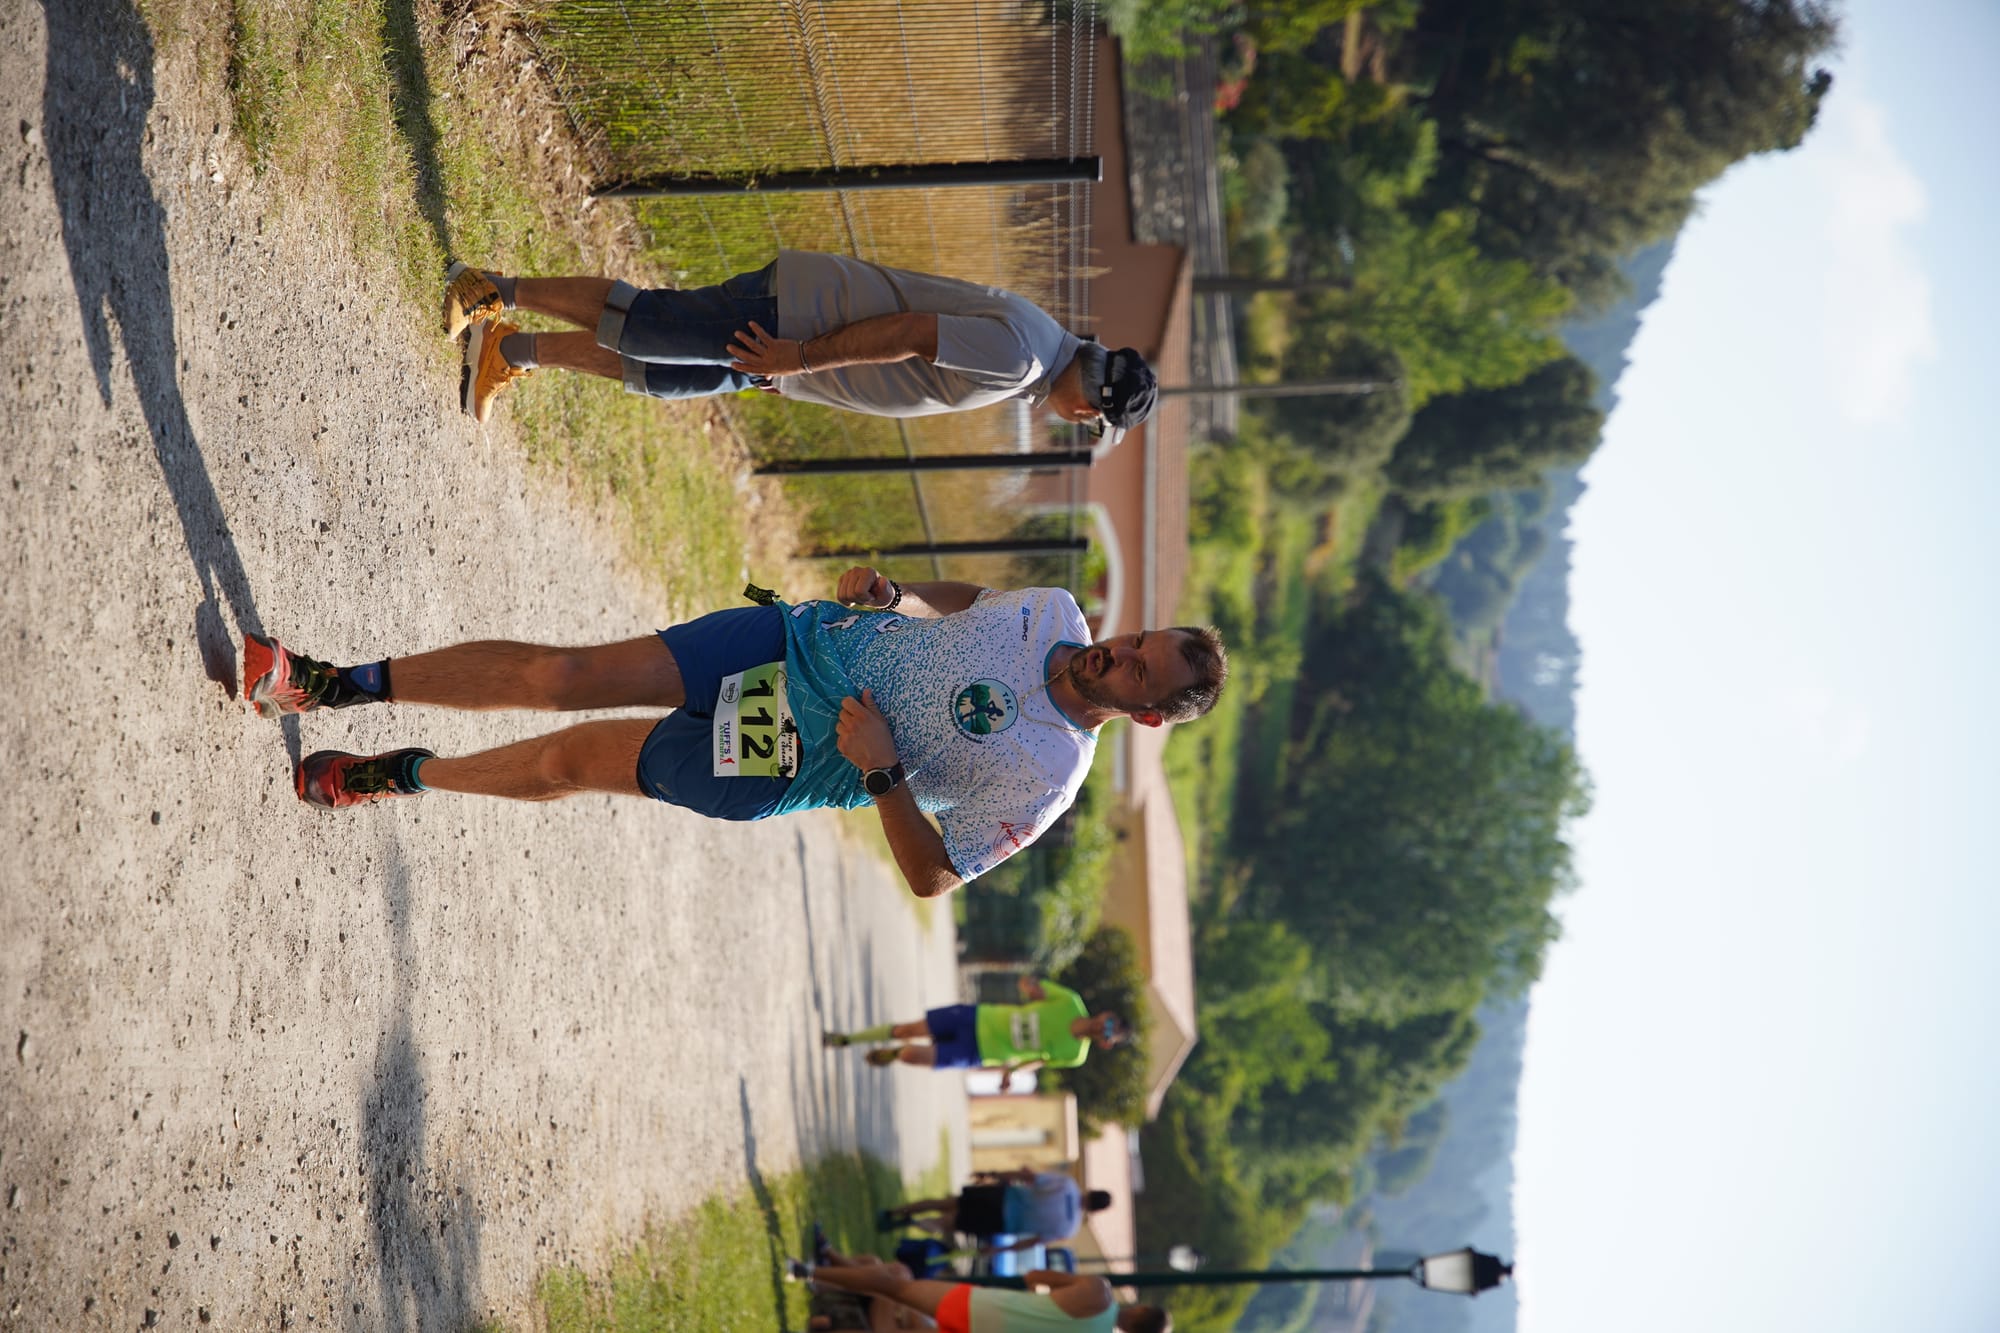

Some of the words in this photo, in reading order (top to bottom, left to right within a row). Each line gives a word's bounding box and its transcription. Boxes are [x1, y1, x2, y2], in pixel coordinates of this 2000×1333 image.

[741, 679, 774, 759] 112
[1002, 692, 1013, 711] TAC
[723, 721, 731, 755] TUFF'S
[785, 716, 794, 752] Clenge
